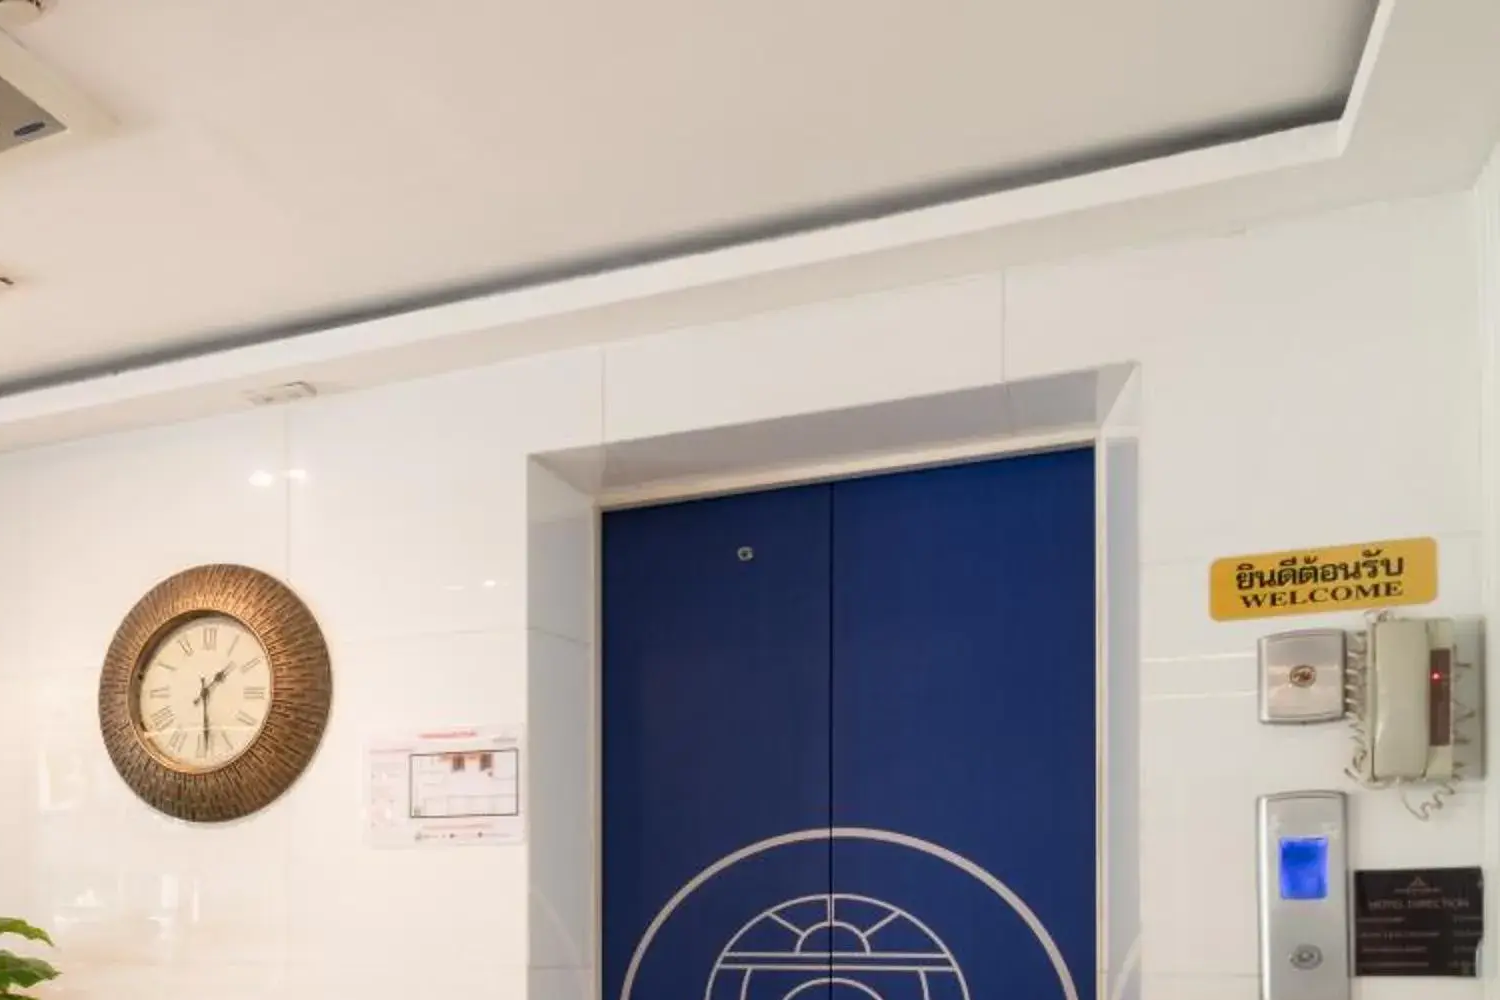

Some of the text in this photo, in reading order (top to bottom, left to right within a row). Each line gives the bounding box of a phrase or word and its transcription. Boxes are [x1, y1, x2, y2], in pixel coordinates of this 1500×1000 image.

[1236, 549, 1404, 591] ยินดีต้อนรับ
[1240, 580, 1404, 609] WELCOME
